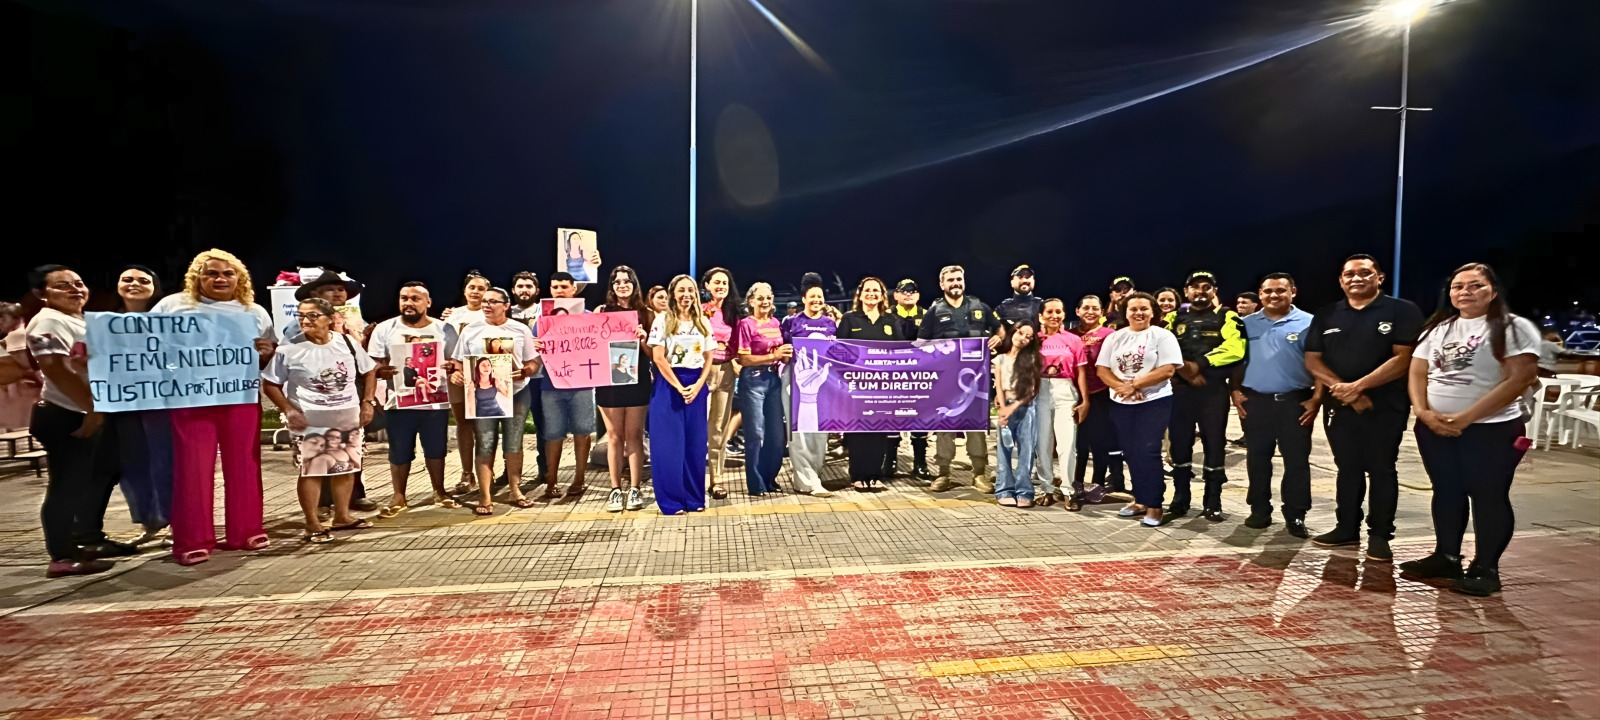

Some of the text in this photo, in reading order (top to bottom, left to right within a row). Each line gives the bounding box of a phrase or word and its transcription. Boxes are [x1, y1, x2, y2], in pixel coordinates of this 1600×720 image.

[108, 315, 202, 334] CONTRA
[146, 336, 160, 352] O
[843, 371, 939, 380] CUIDAR DA VIDA
[848, 379, 933, 390] É UM DIREITO!
